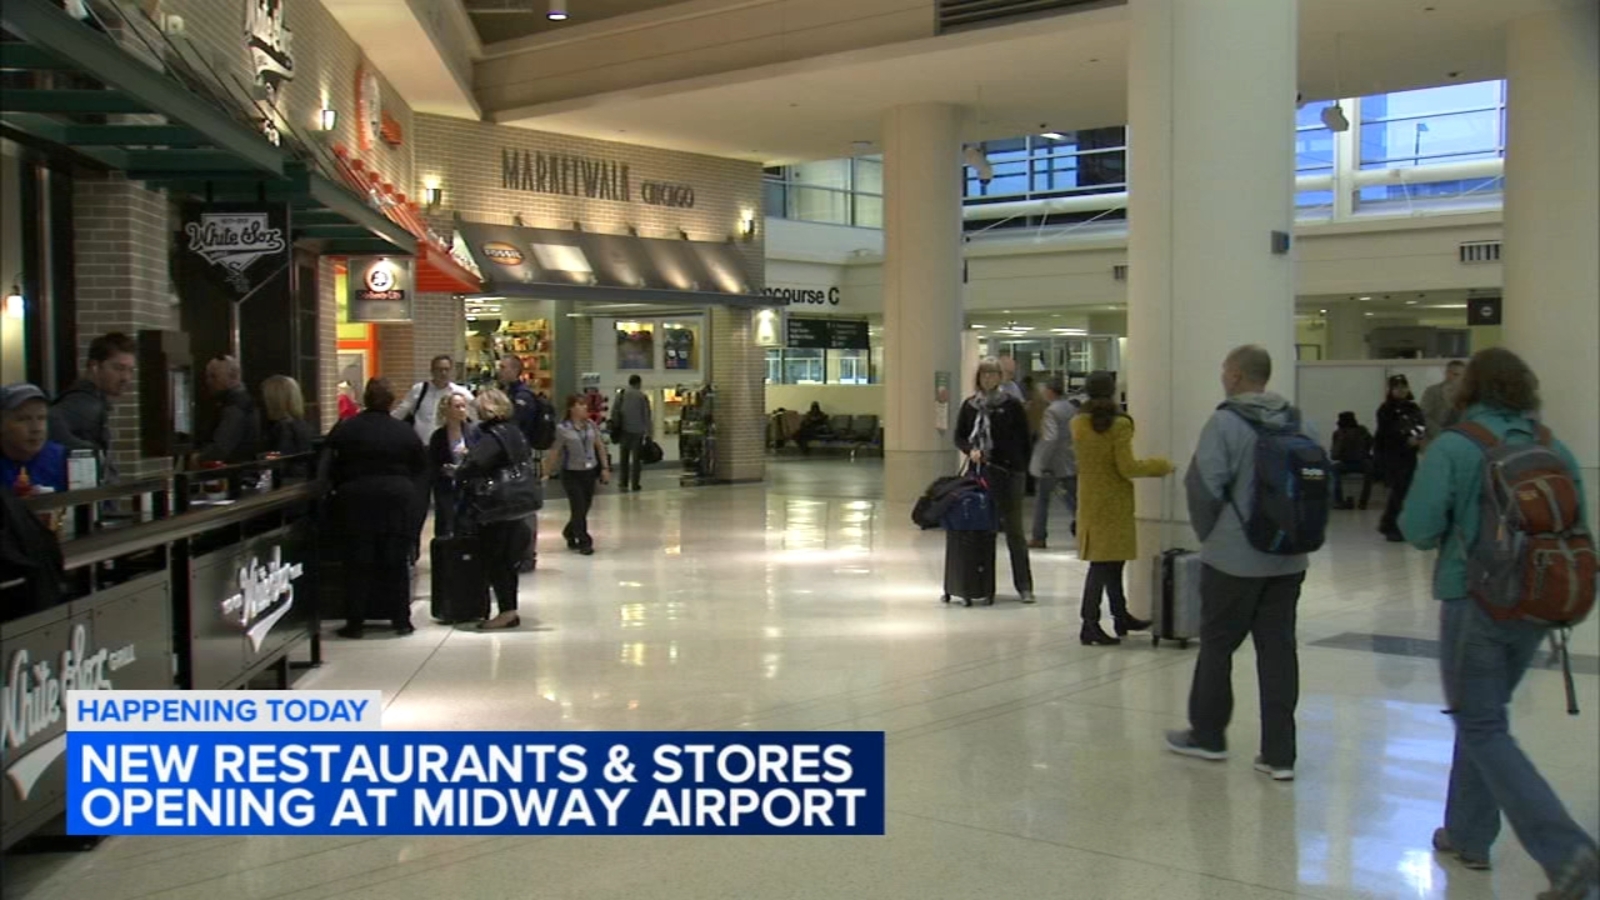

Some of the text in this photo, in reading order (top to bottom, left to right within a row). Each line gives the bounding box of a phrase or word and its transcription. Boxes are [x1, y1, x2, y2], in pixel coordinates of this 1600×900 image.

[502, 146, 695, 209] MARKETWALK CHICAGO
[185, 220, 281, 250] White Sox
[828, 286, 840, 306] C
